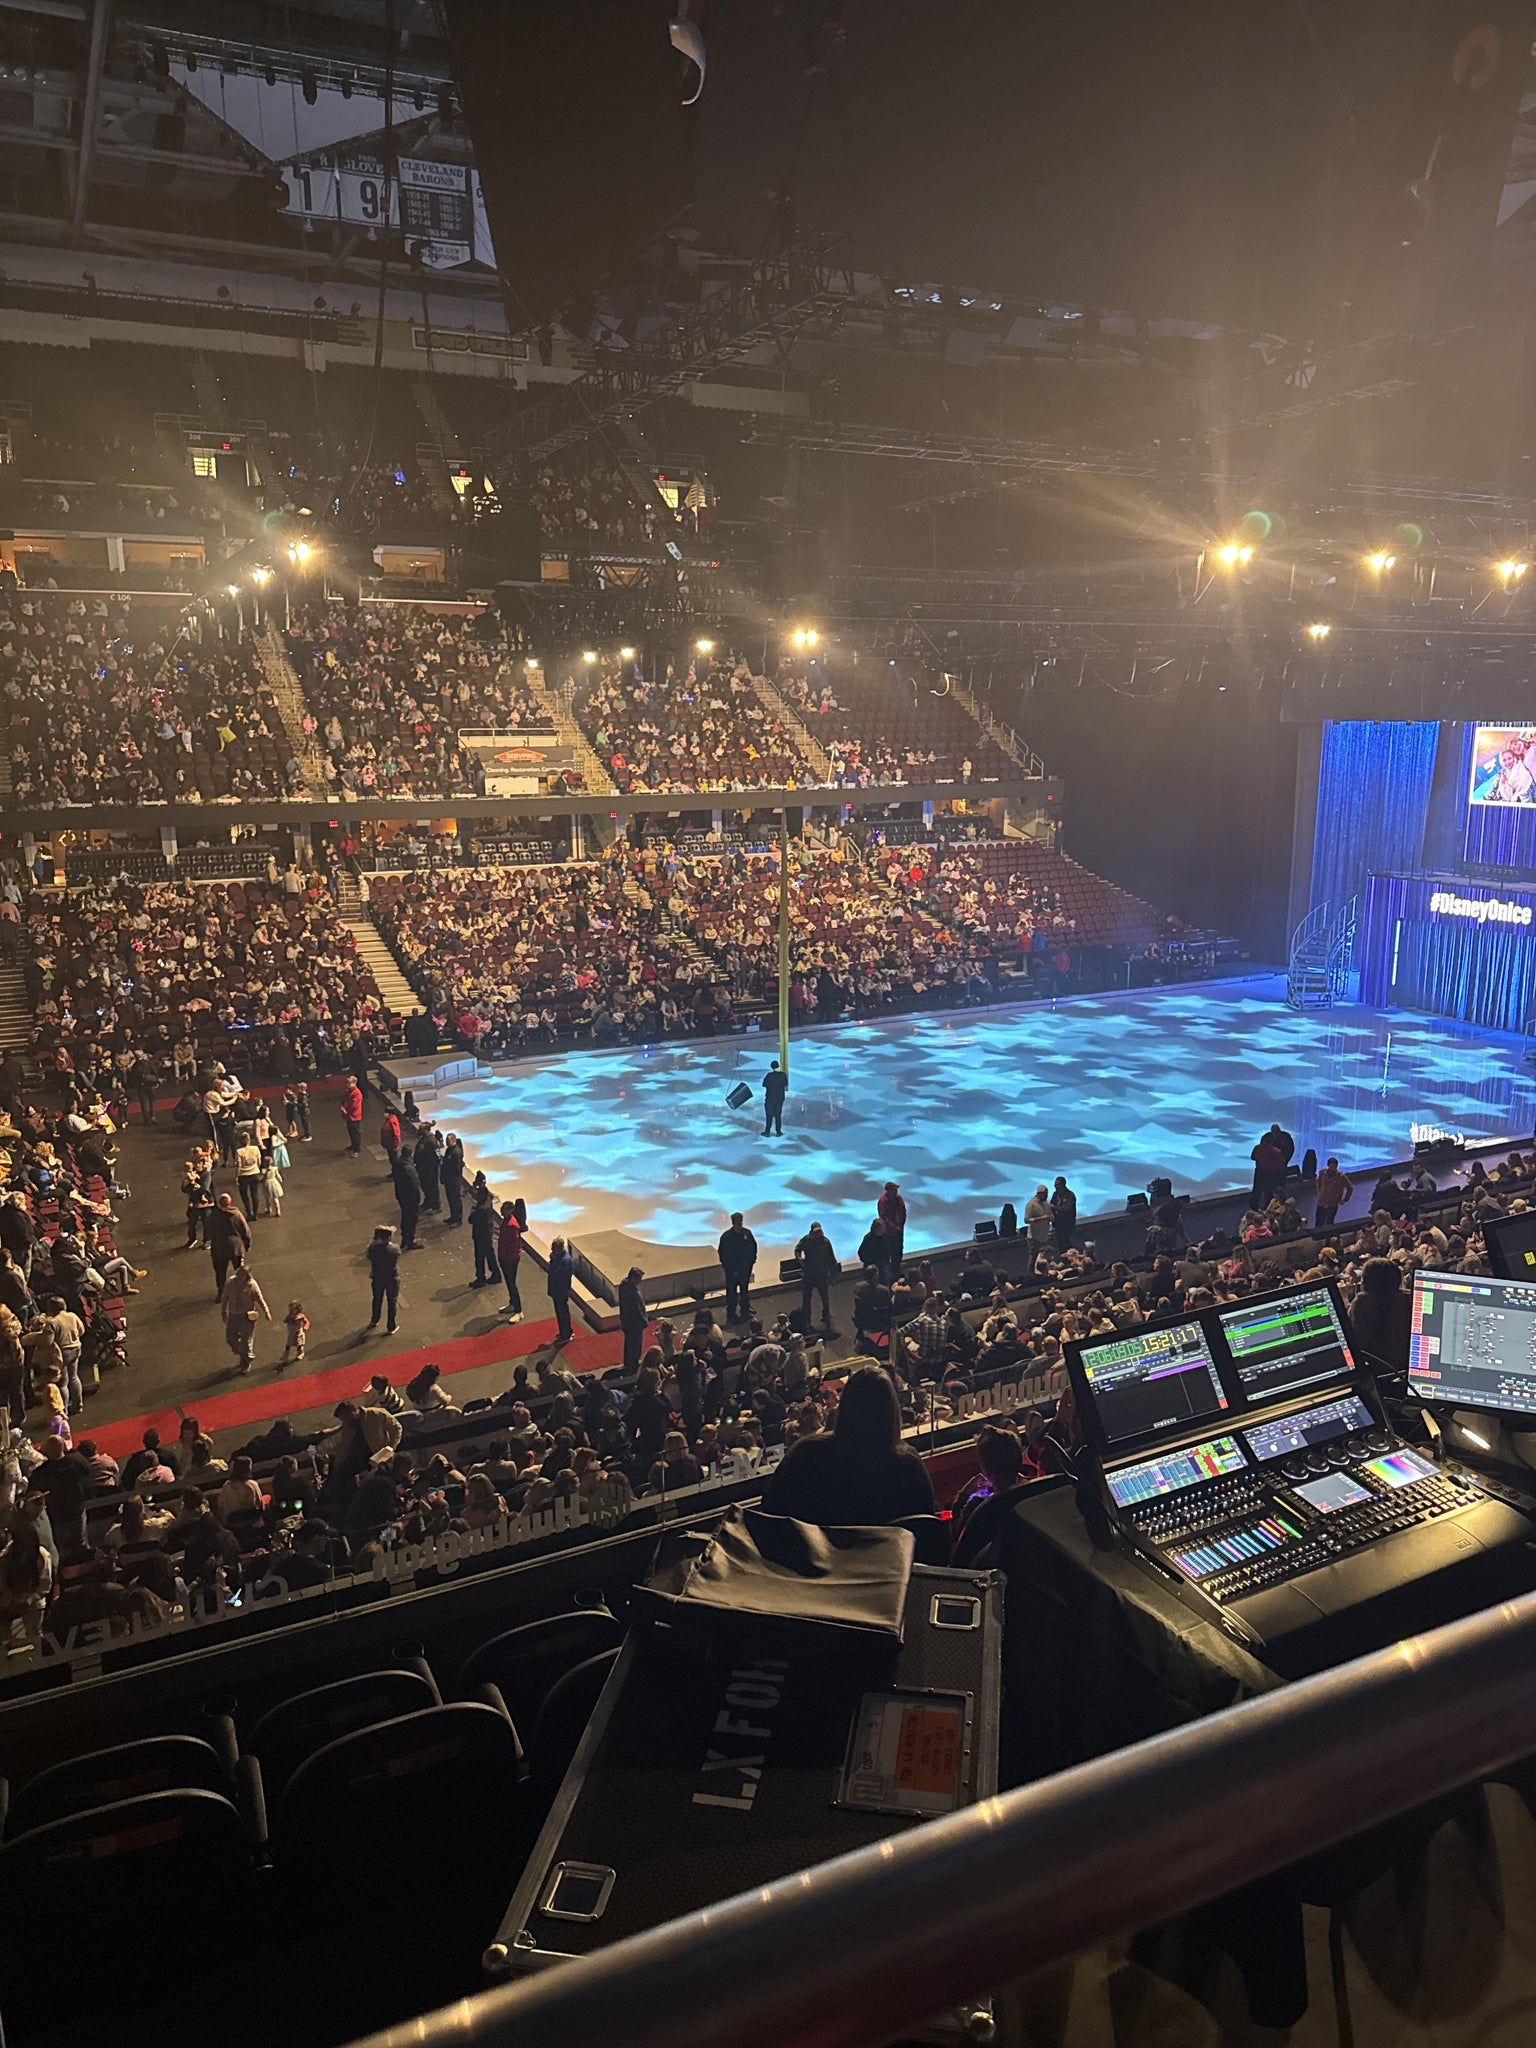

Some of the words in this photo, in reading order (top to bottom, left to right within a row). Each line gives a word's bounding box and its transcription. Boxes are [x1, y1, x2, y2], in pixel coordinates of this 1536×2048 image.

[344, 159, 384, 174] GLOVE
[401, 161, 464, 178] CLEVELAND
[412, 173, 455, 187] BARONS
[360, 180, 378, 218] 9
[1430, 892, 1533, 925] #DisneyOnIce
[1142, 1327, 1198, 1353] 15:21:17
[692, 1749, 766, 1810] LX
